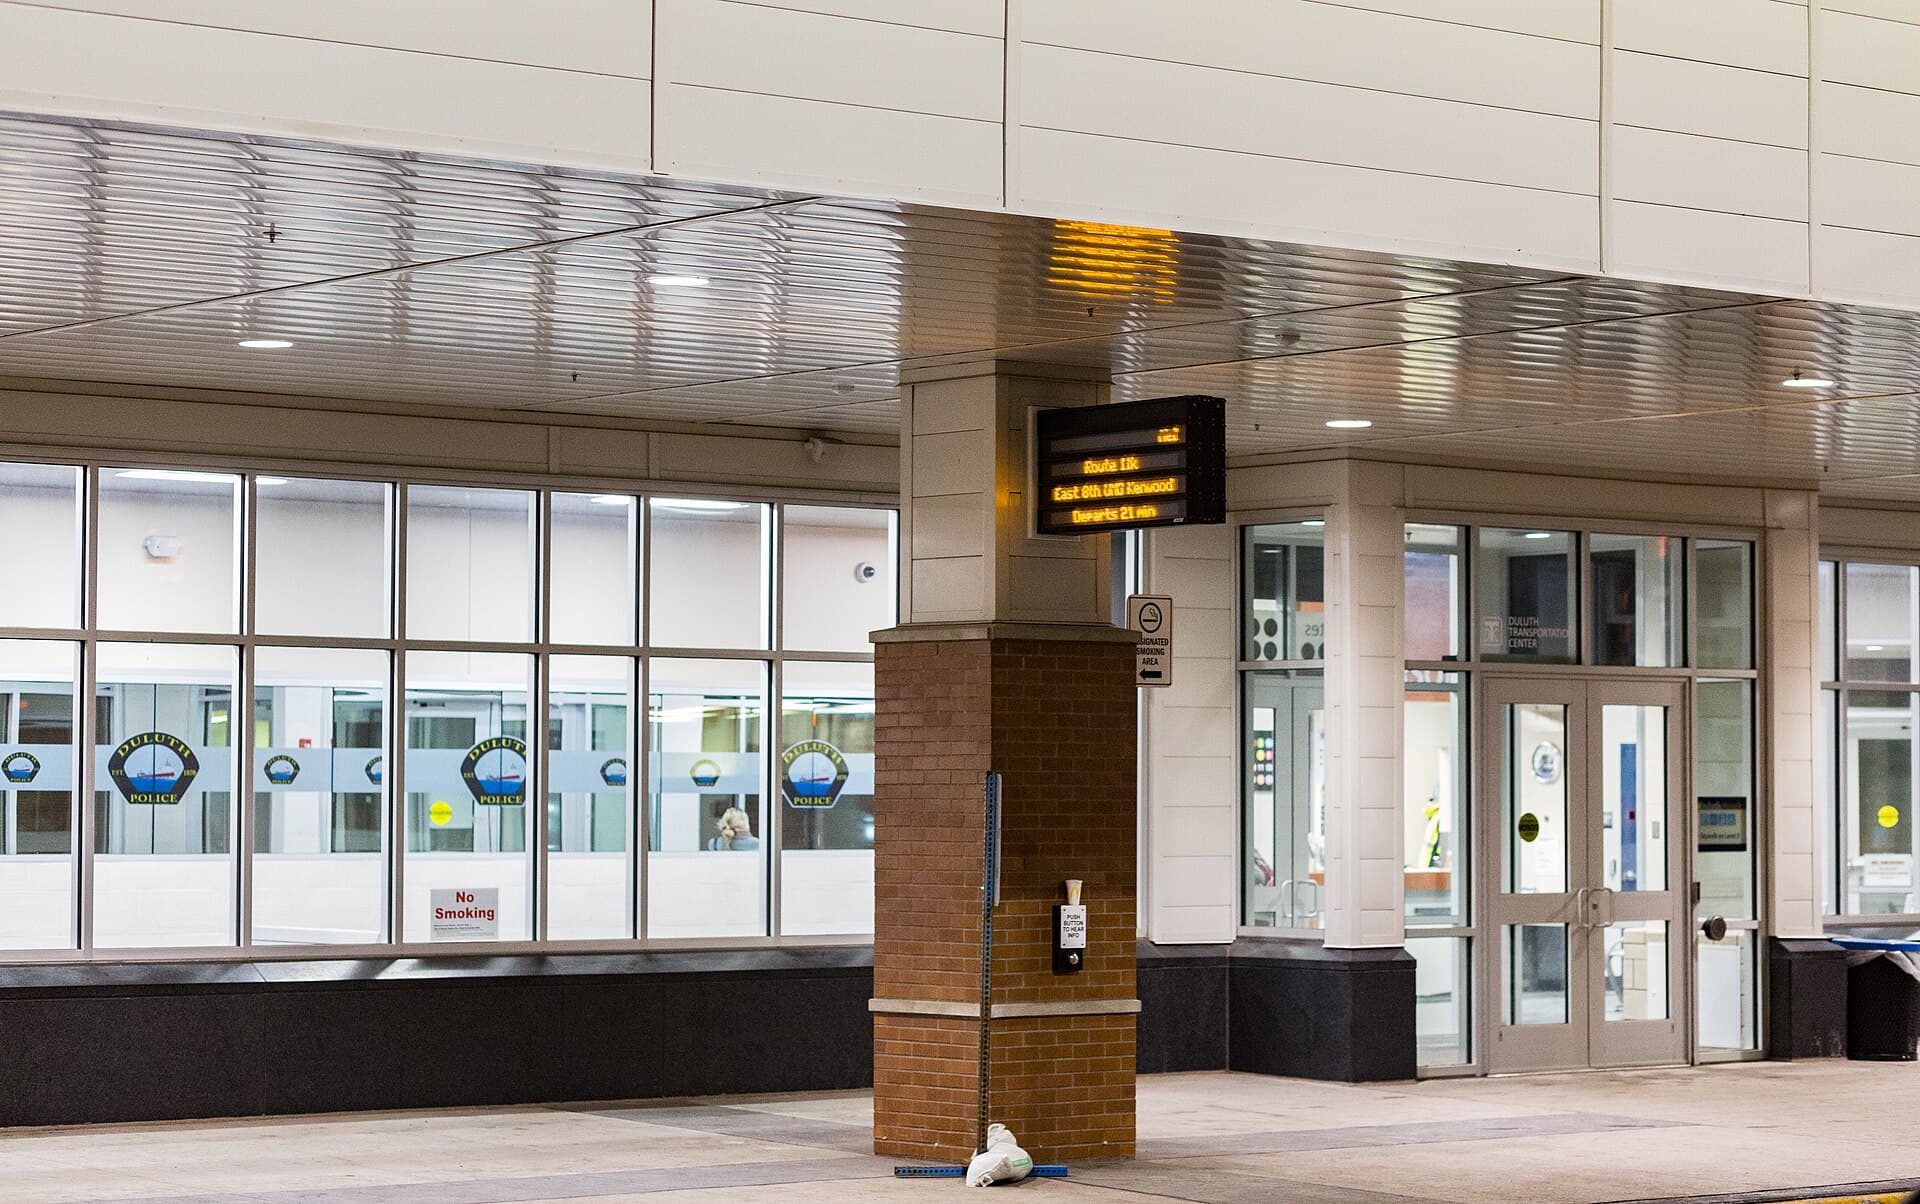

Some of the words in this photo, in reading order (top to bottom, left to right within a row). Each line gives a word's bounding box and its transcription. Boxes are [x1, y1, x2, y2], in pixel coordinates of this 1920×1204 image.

[1083, 459, 1117, 474] Route
[1053, 486, 1079, 502] East
[1081, 484, 1101, 499] 8th
[1126, 478, 1178, 496] Kenwood
[1072, 507, 1118, 524] Departs
[1136, 505, 1157, 519] min
[1508, 616, 1540, 626] DULUTH
[1509, 627, 1568, 638] TRANSPORTATIO
[1508, 638, 1538, 648] CENTER
[1136, 647, 1164, 655] SMOKING
[117, 733, 191, 758] DULUTH
[783, 742, 842, 764] DULUTH
[130, 793, 178, 803] POLICE
[480, 795, 523, 804] POLICE
[793, 796, 833, 805] POLICE
[456, 890, 475, 903] No
[435, 906, 495, 921] Smoking
